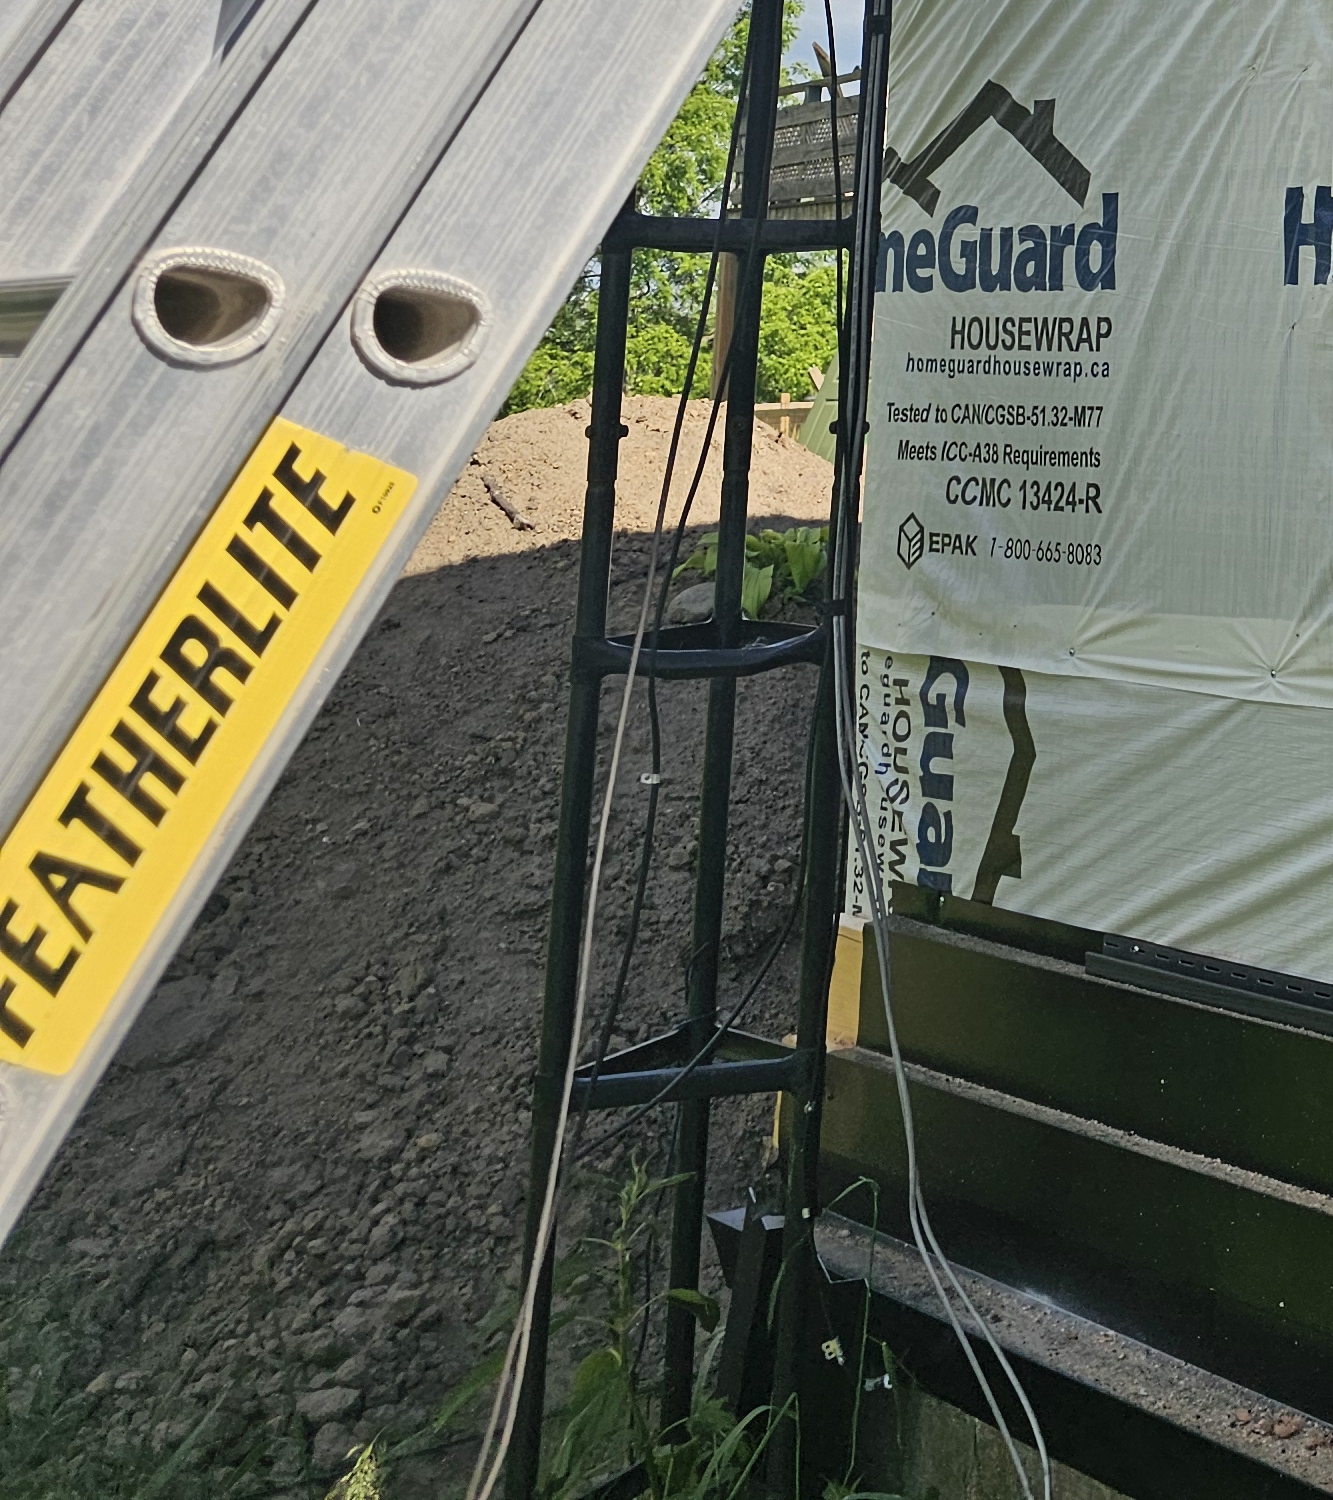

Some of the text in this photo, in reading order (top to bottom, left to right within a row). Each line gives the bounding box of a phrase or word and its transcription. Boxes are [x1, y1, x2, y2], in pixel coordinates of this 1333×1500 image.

[950, 316, 1112, 352] HOUSEWRAP
[906, 352, 1110, 382] homeguardhousewrap.ca
[887, 402, 1103, 428] Tested to CAN/CGSB-51.32-M77
[898, 440, 1101, 471] Meets ICC-A38 Requirements
[946, 475, 1102, 514] CCMC 13424-R
[928, 532, 1102, 566] EPAK 1-800-665-8083
